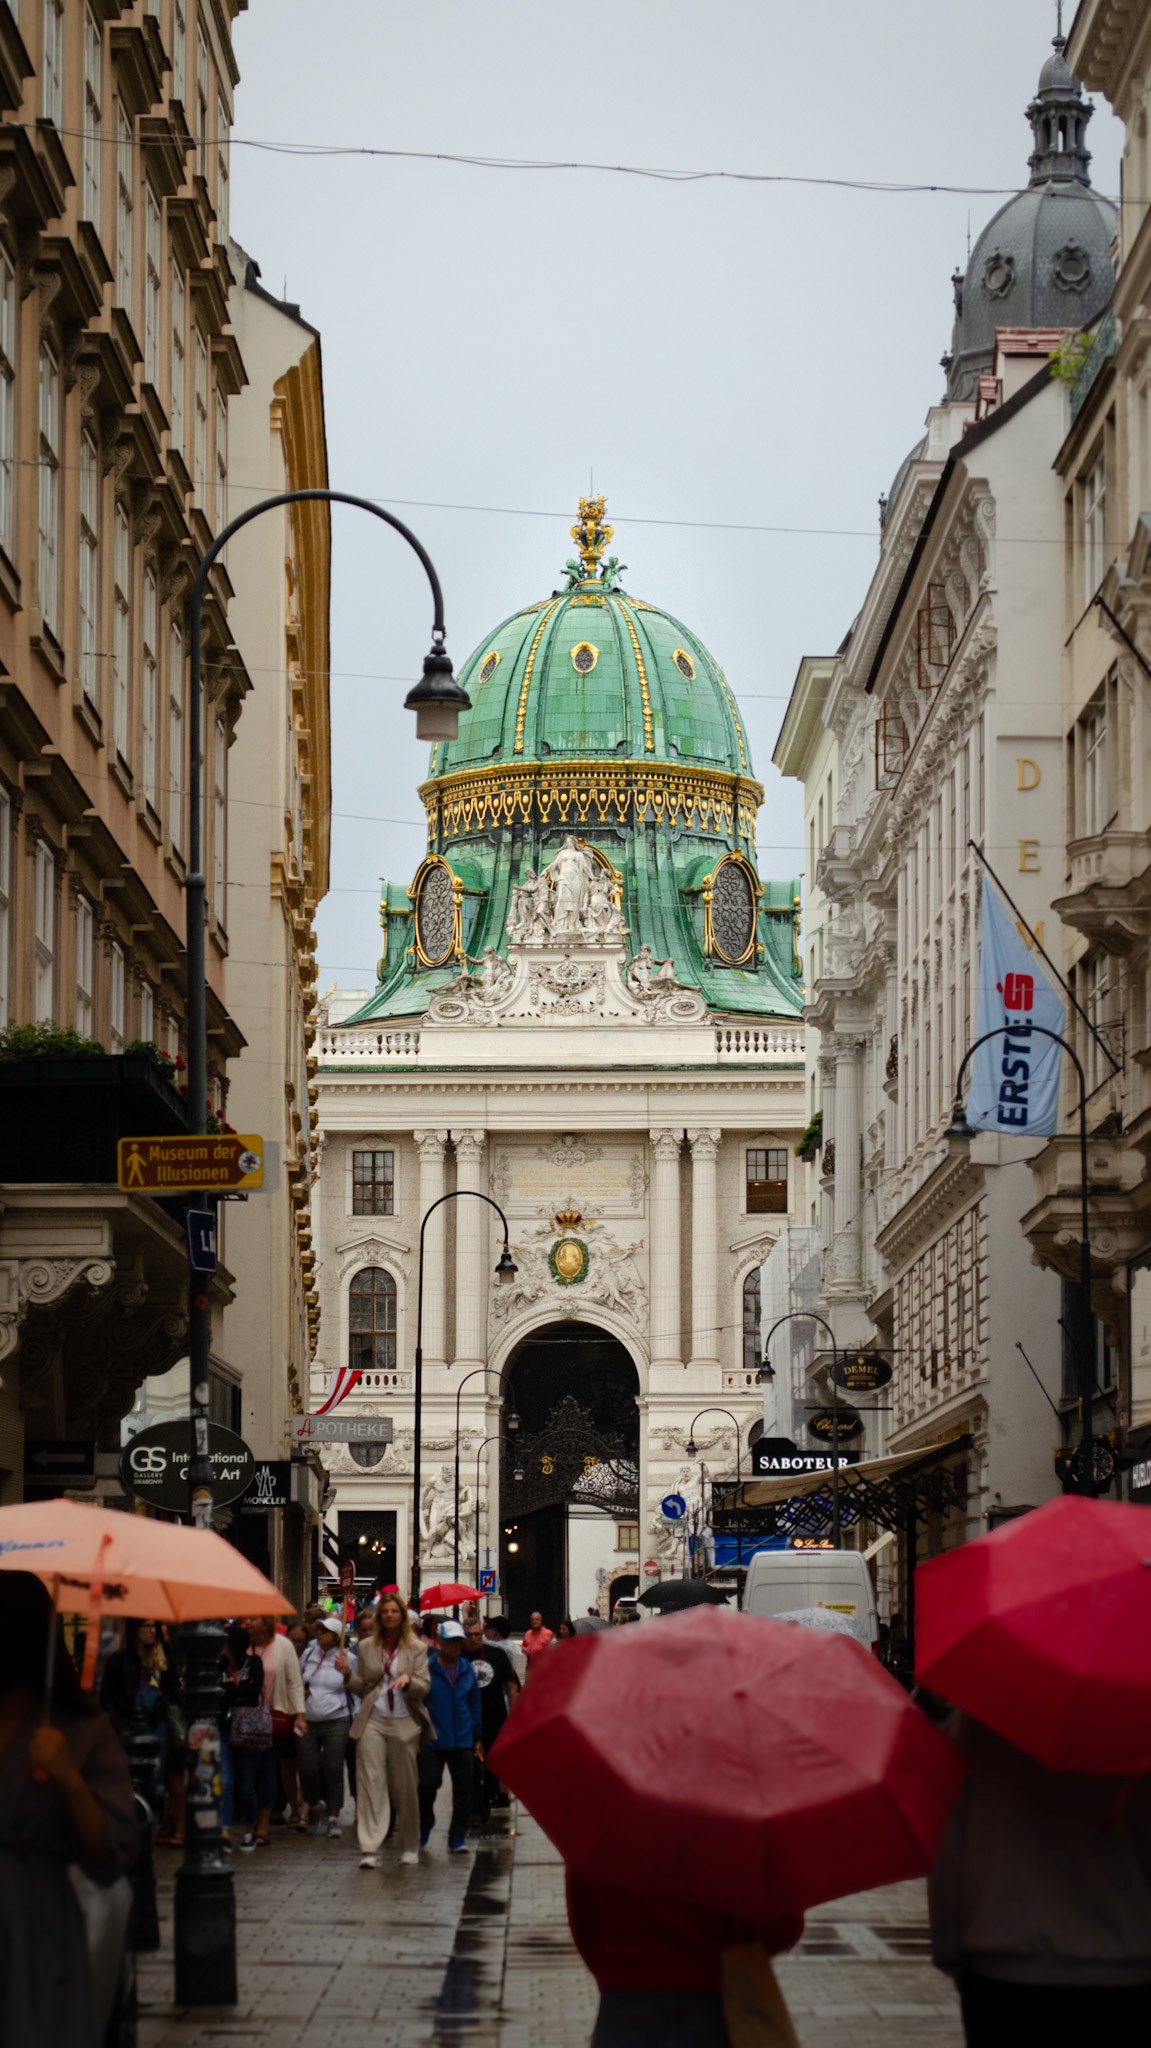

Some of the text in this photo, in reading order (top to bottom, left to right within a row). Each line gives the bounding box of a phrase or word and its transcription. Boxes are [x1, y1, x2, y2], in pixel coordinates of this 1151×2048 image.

[998, 1015, 1032, 1126] ERSTE
[149, 1144, 237, 1161] Museum der
[157, 1164, 229, 1182] Illusionen
[843, 1365, 879, 1375] DEMEL
[297, 1418, 389, 1437] APOTHEKE
[129, 1446, 167, 1472] GS
[172, 1451, 248, 1463] Intational
[759, 1456, 849, 1469] SABOTEUR
[220, 1467, 241, 1480] Art
[243, 1496, 287, 1505] MONCLER
